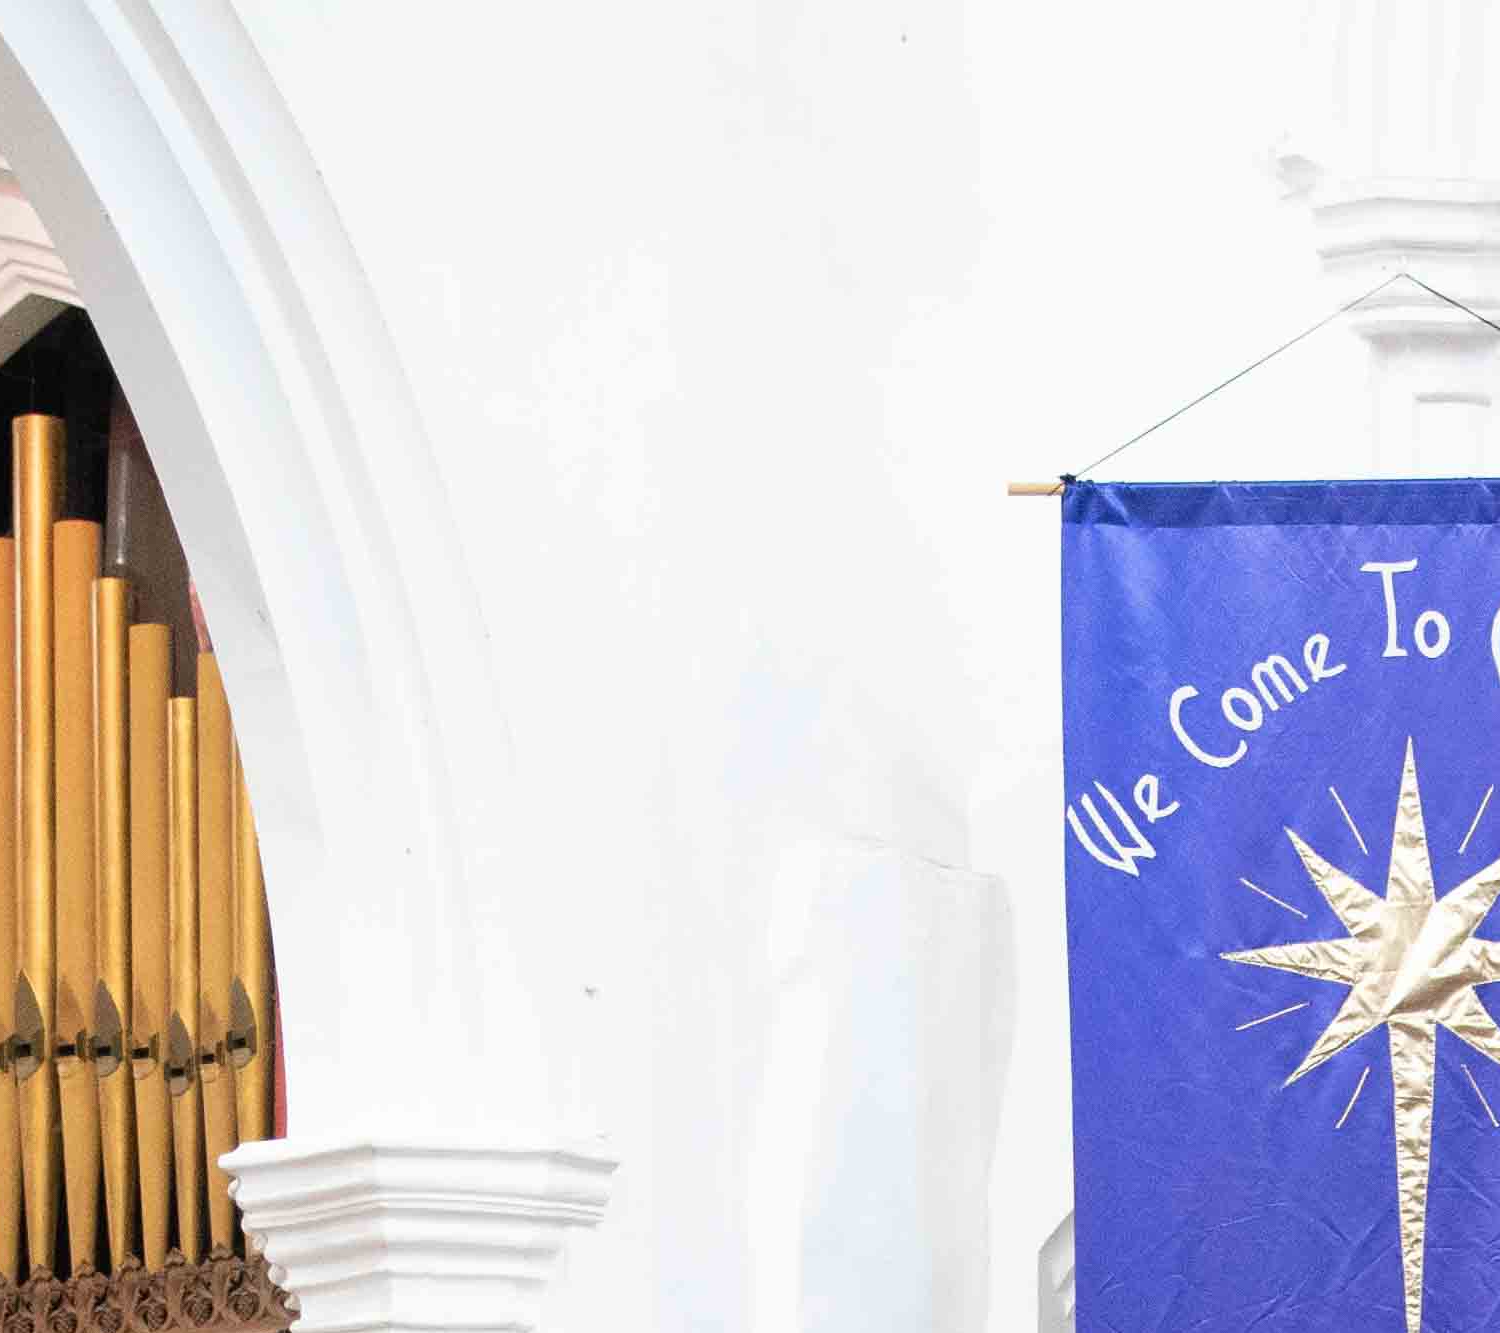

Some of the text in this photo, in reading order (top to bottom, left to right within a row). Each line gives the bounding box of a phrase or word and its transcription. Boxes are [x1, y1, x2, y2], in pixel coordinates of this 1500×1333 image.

[1066, 773, 1181, 877] We
[1169, 633, 1347, 768] Come
[1360, 558, 1451, 658] To
